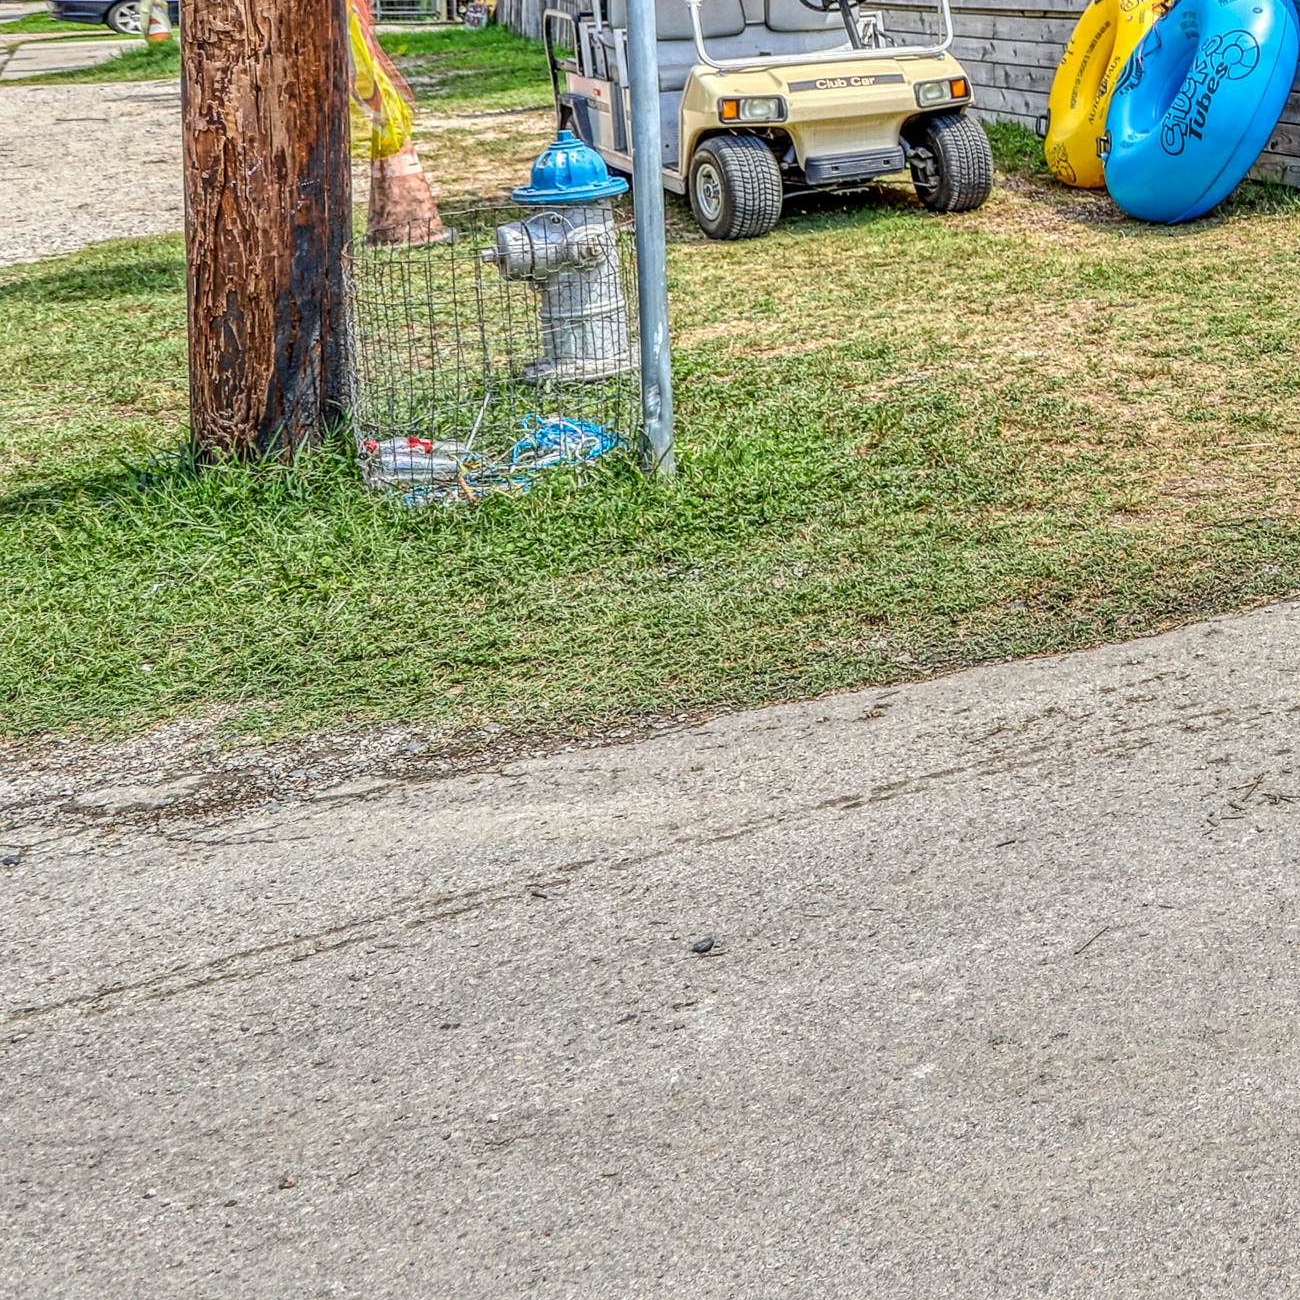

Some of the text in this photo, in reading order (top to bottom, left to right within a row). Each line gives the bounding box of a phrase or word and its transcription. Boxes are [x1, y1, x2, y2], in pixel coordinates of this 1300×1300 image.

[815, 76, 876, 89] Club Car
[1184, 61, 1229, 141] Tubes
